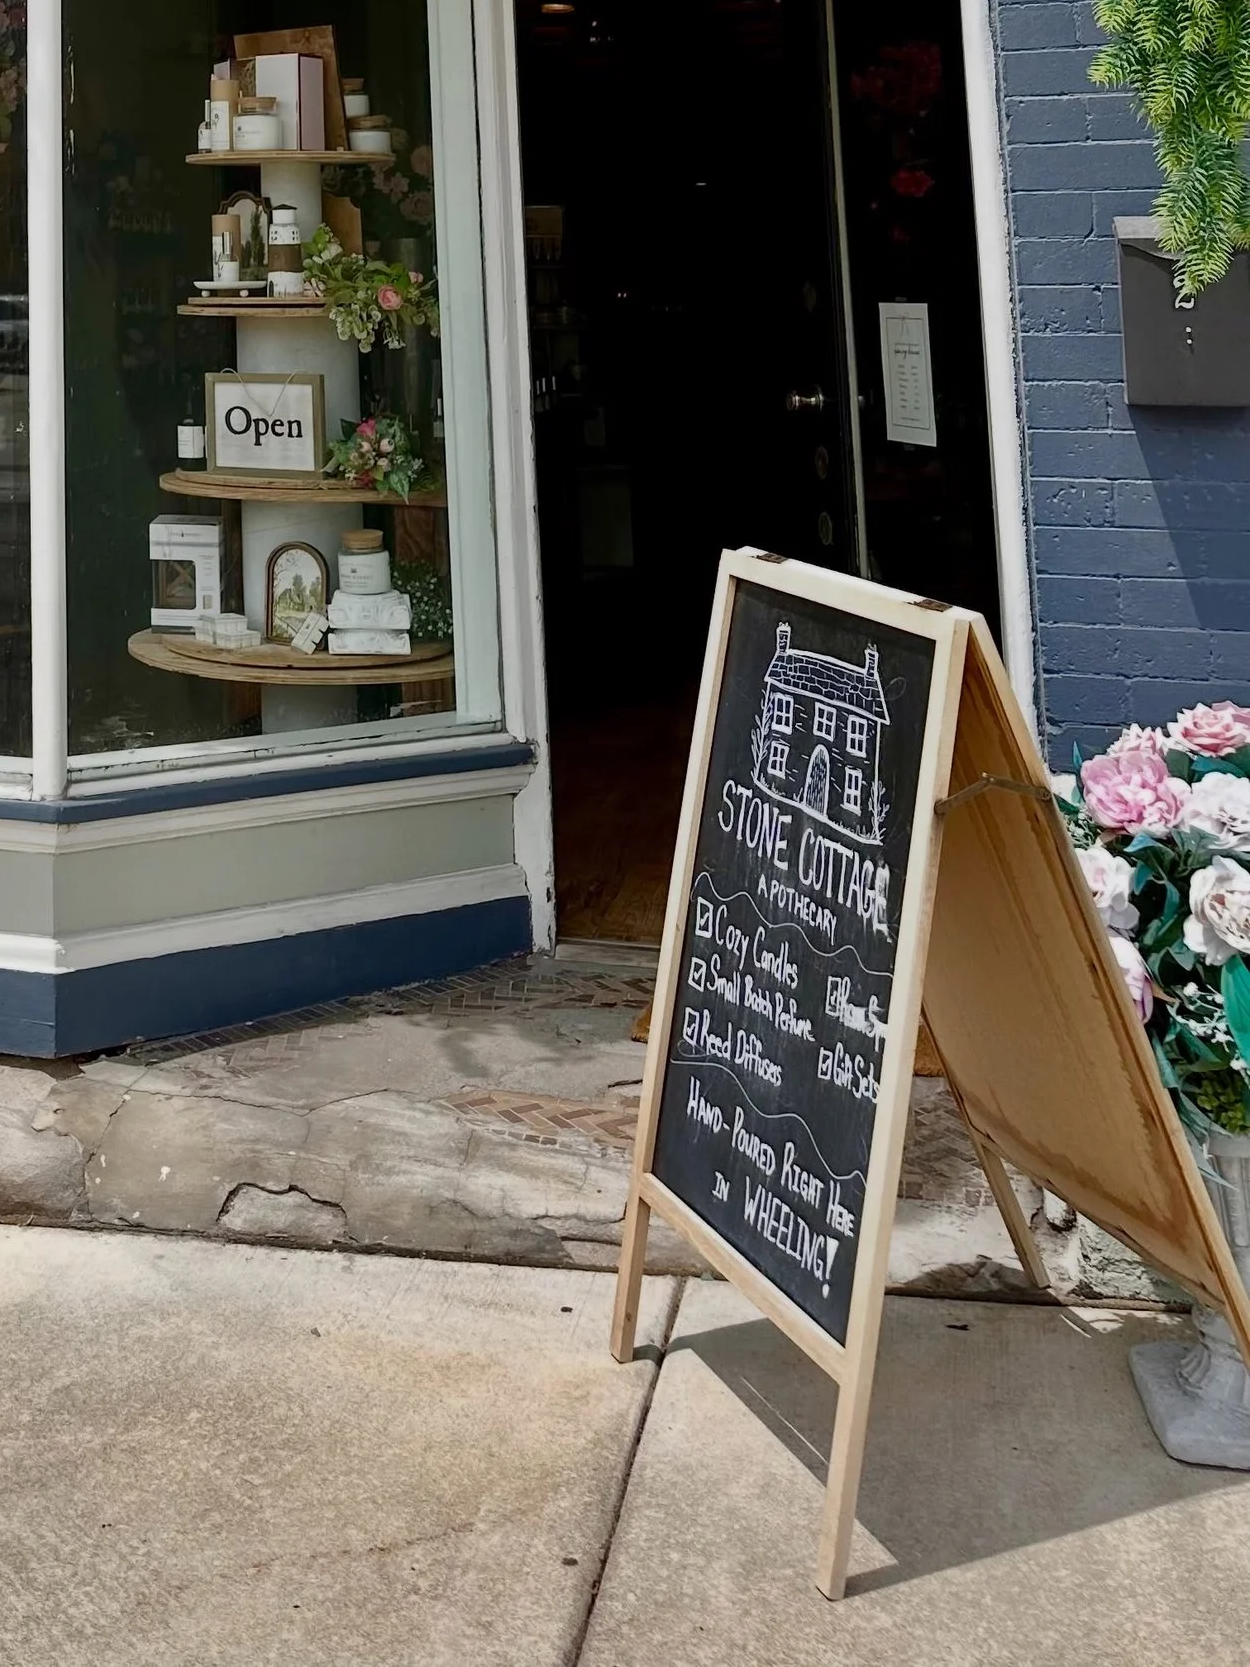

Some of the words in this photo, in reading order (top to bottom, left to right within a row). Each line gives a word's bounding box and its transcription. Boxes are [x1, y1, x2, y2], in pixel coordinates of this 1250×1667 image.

[225, 406, 303, 446] Open
[718, 779, 792, 871] STONE
[799, 828, 891, 936] COTTAGE
[716, 905, 750, 971] Cozy
[753, 926, 798, 989] Candles
[758, 874, 837, 946] APOTHECARY
[707, 954, 741, 1007] Small
[744, 975, 773, 1021] Batch
[775, 992, 815, 1041] Perfume
[701, 1009, 732, 1061] Reed
[734, 1030, 782, 1087] Diffusers
[834, 1041, 854, 1090] Gift
[852, 1054, 880, 1104] Sets
[712, 1171, 730, 1202] IN
[744, 1176, 840, 1299] WHEELING!
